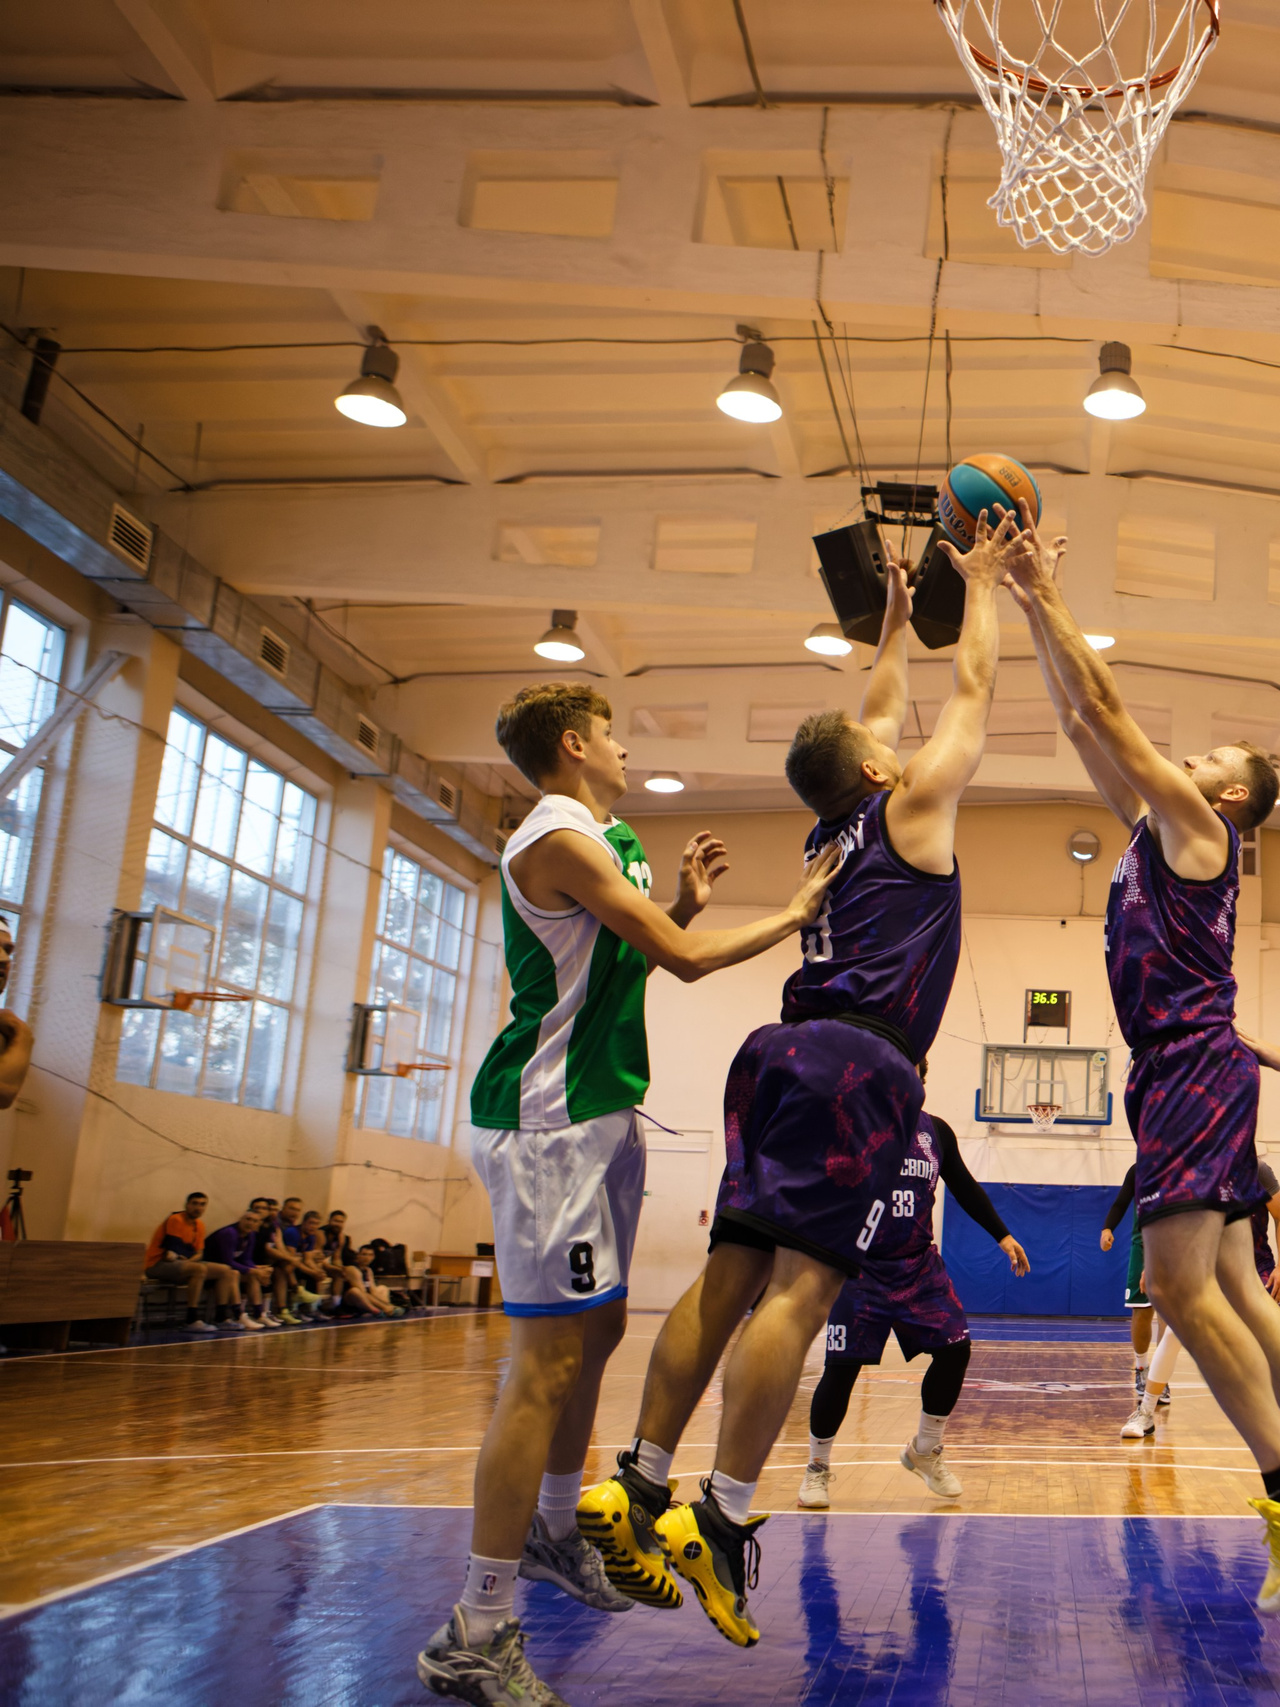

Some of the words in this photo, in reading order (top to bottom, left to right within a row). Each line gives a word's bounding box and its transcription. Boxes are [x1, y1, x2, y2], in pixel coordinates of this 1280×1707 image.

[1033, 992, 1058, 1005] 36.6
[892, 1190, 915, 1218] 33
[856, 1199, 886, 1252] 9
[569, 1240, 596, 1293] 9
[827, 1324, 847, 1352] 33
